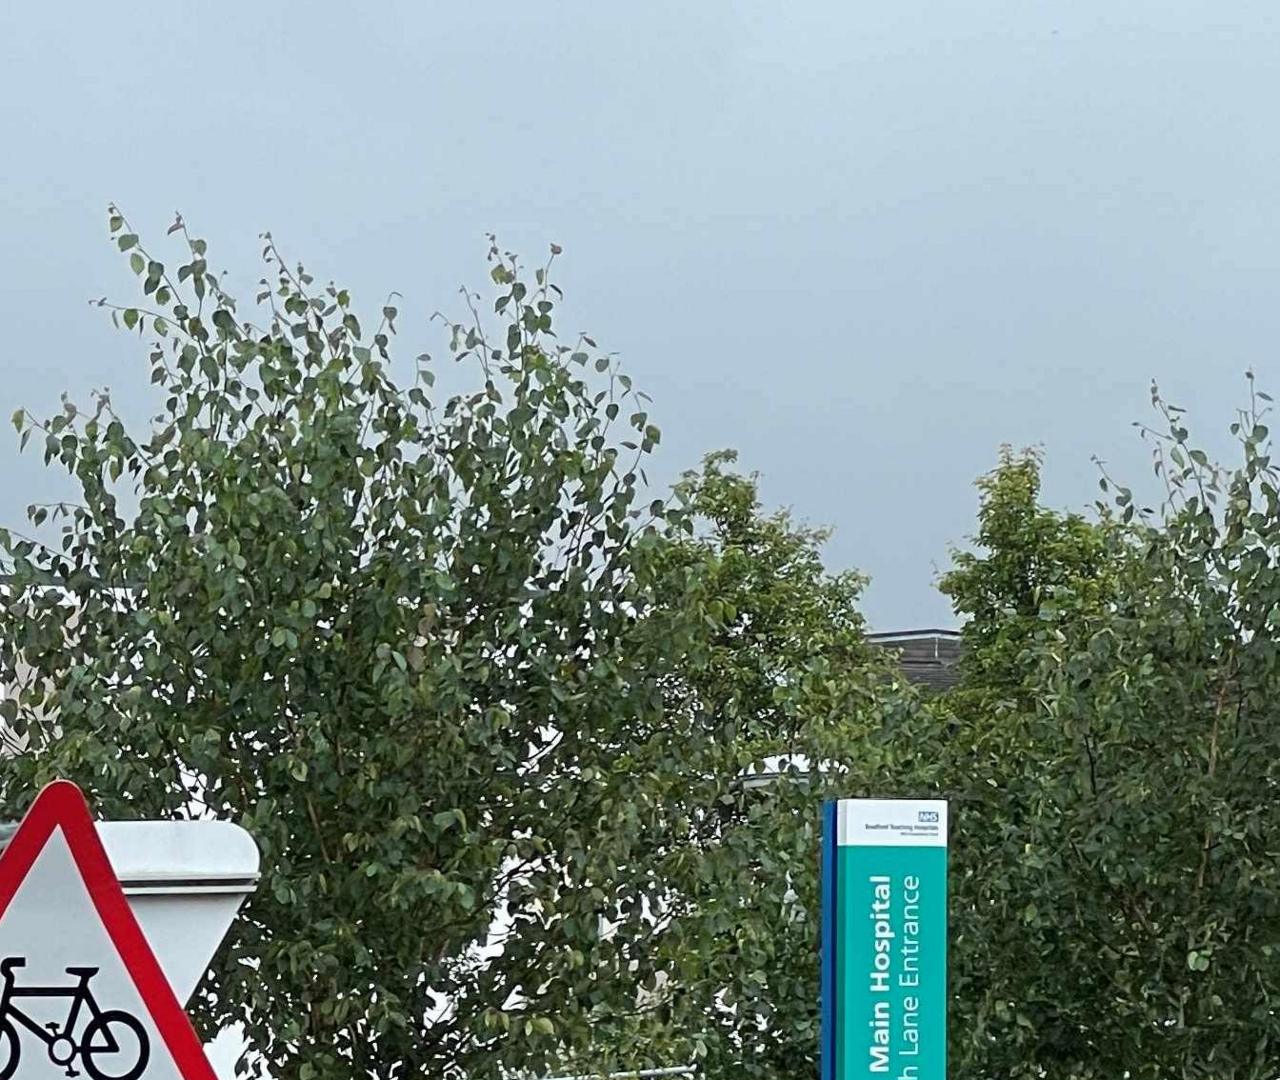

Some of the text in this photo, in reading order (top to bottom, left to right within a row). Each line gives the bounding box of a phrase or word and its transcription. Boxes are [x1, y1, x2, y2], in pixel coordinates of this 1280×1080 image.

[869, 876, 896, 1072] Main Hospital
[898, 875, 920, 986] Entrance
[899, 996, 919, 1055] Lane
